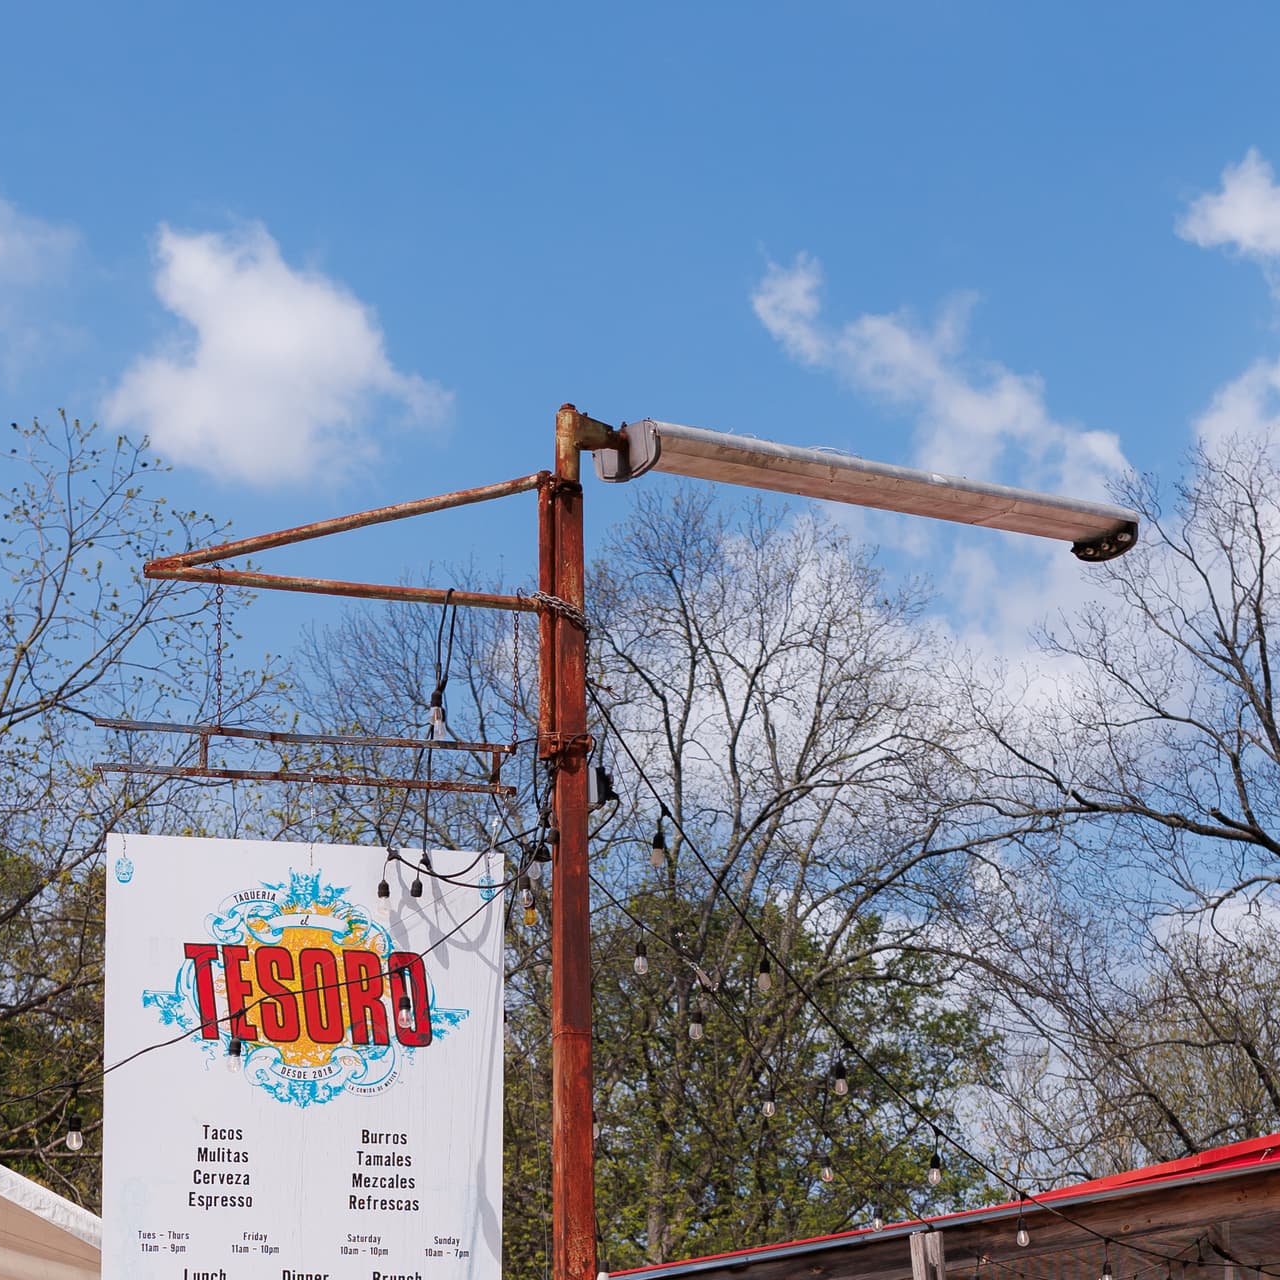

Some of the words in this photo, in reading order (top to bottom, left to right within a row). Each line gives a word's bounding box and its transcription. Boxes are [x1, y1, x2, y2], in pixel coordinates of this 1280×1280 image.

[233, 890, 277, 904] TAQUERIA
[300, 915, 310, 926] el
[183, 942, 433, 1048] TESORO
[280, 1066, 307, 1080] DESDE
[312, 1066, 333, 1079] 2018
[202, 1124, 243, 1141] Tacos
[361, 1129, 408, 1145] Burros
[197, 1147, 249, 1163] Mulitas
[356, 1151, 412, 1167] Tamales
[193, 1169, 250, 1186] Cerveza
[351, 1173, 416, 1189] Mezcales
[188, 1191, 253, 1210] Espresso
[349, 1195, 420, 1211] Refrescas
[138, 1230, 156, 1240] Tues
[167, 1230, 190, 1240] Thurs
[243, 1232, 268, 1242] Friday
[347, 1233, 381, 1245] Saturday
[434, 1236, 460, 1247] Sunday
[141, 1243, 159, 1253] 11am
[170, 1243, 186, 1254] 9pm
[231, 1244, 249, 1254] 11am
[261, 1244, 280, 1255] 10pm
[340, 1246, 359, 1256] 10am
[369, 1246, 389, 1256] 10pm
[424, 1248, 443, 1257] 10am
[454, 1249, 470, 1258] 7pm
